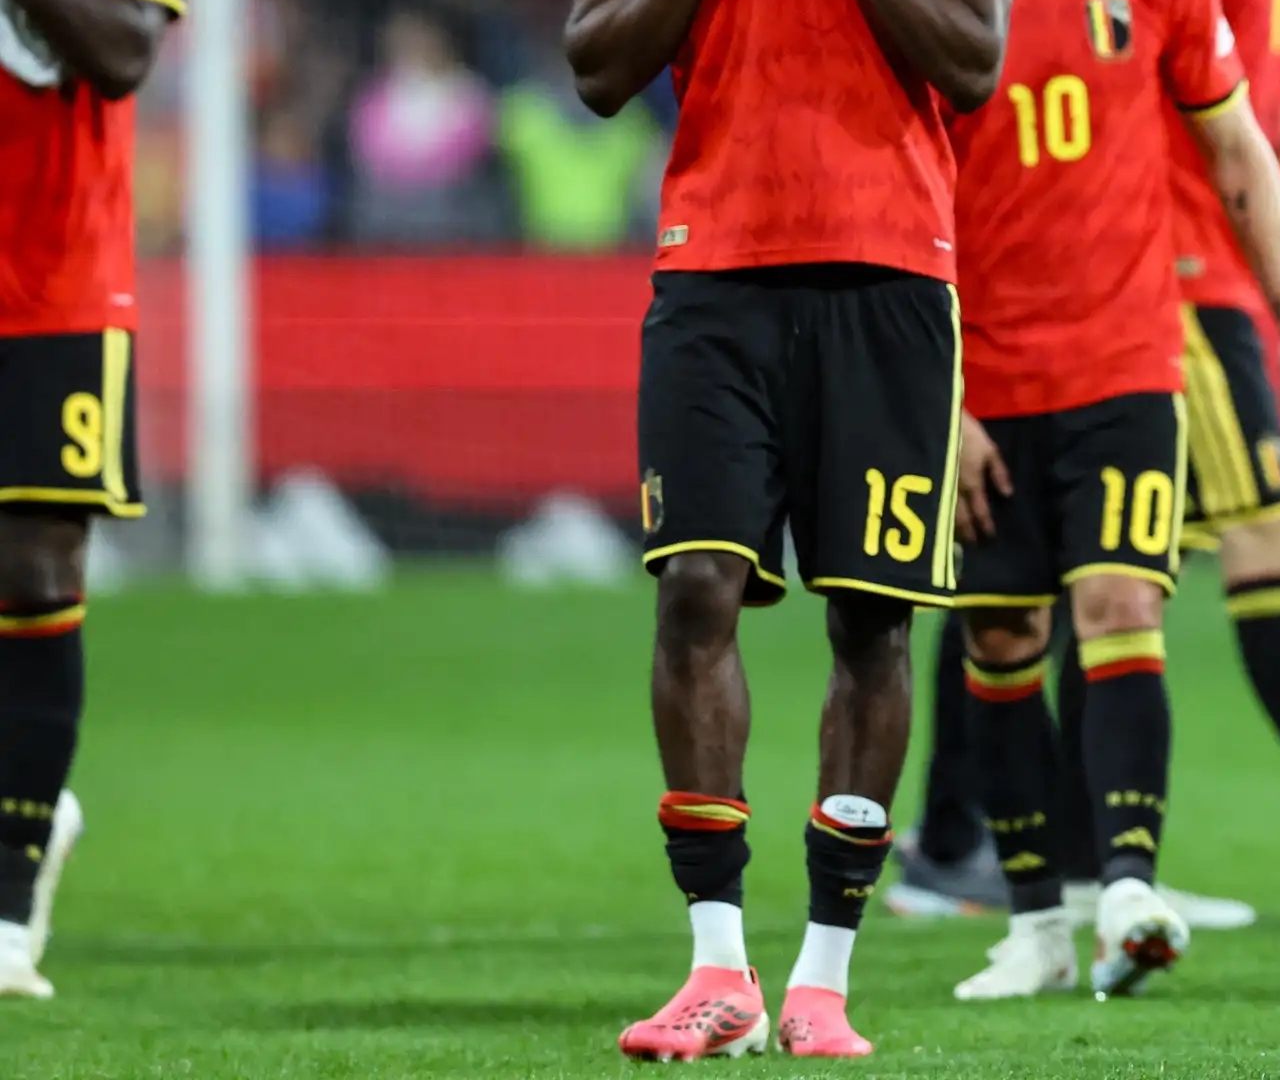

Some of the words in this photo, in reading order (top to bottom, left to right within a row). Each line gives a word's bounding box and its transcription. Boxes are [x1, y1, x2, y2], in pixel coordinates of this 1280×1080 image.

[1007, 74, 1092, 167] 10
[61, 391, 102, 478] 9
[863, 468, 933, 562] 15
[1100, 466, 1174, 556] 10
